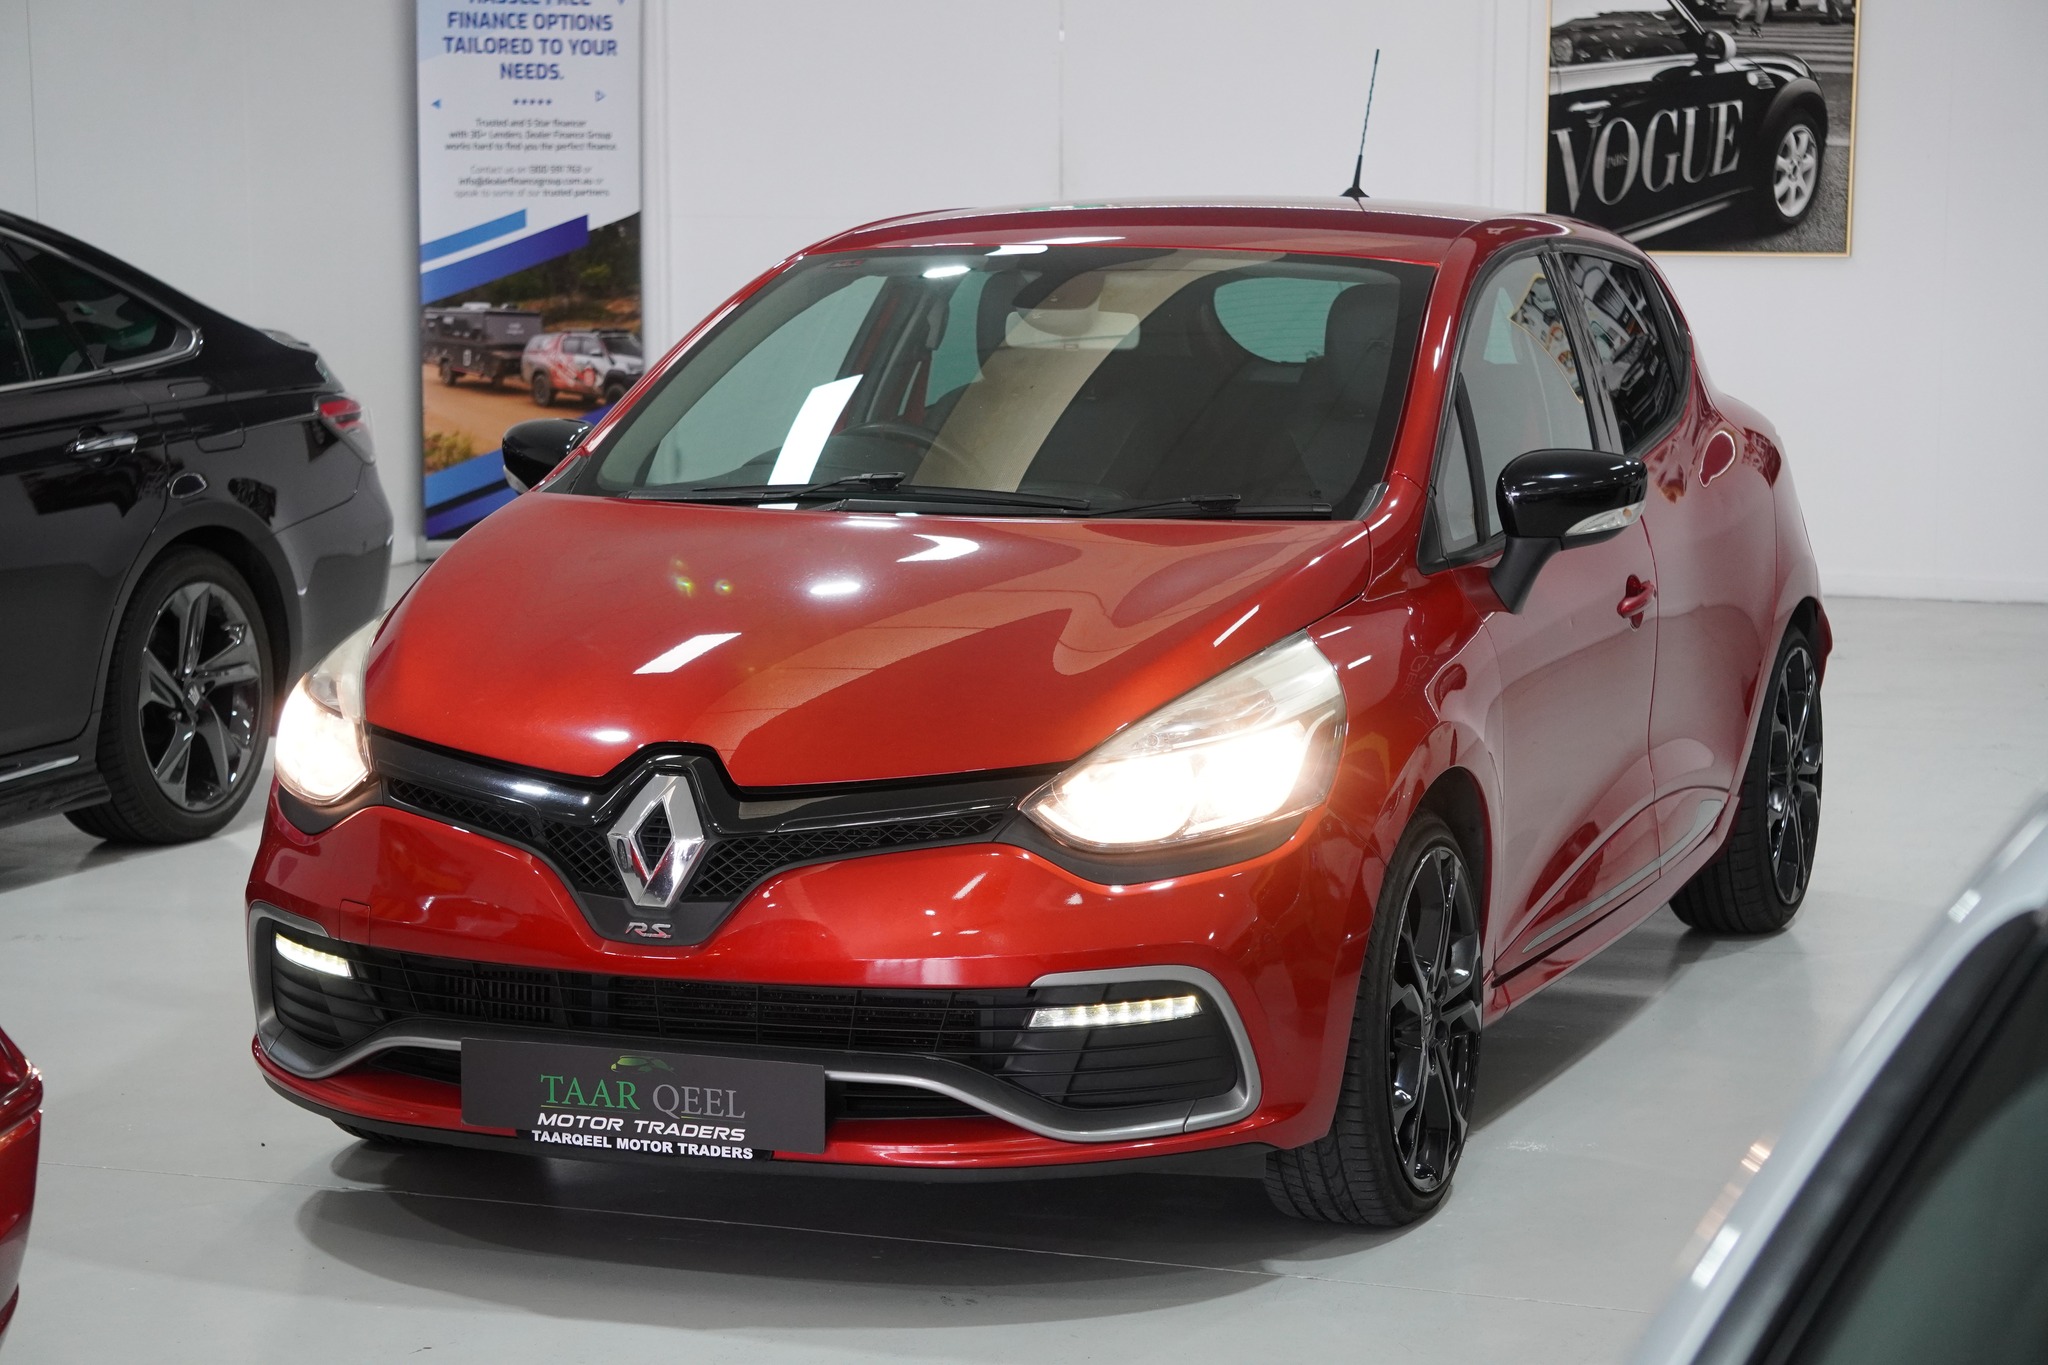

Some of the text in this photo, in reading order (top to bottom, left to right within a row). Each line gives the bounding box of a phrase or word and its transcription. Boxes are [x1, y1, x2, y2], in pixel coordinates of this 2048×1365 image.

[447, 12, 614, 31] FINANCE OPTIONS
[443, 36, 618, 56] TAILORED TO YOUR
[499, 62, 565, 80] NEEDS.
[476, 118, 507, 127] Trusted
[510, 118, 525, 127] and
[449, 130, 467, 140] with
[525, 130, 551, 140] Dealer
[553, 131, 585, 140] Finance
[587, 131, 613, 141] Group
[474, 142, 492, 151] hard
[506, 142, 521, 151] find
[524, 143, 538, 152] you
[541, 142, 553, 151] the
[555, 142, 584, 152] perfect
[1551, 99, 1743, 214] VOGUE
[625, 922, 671, 938] RS
[540, 1074, 746, 1119] TAAR QEEL
[537, 1112, 746, 1142] MOTOR TRADERS
[531, 1130, 753, 1160] TAARQEEL MOTOR TRADERS
